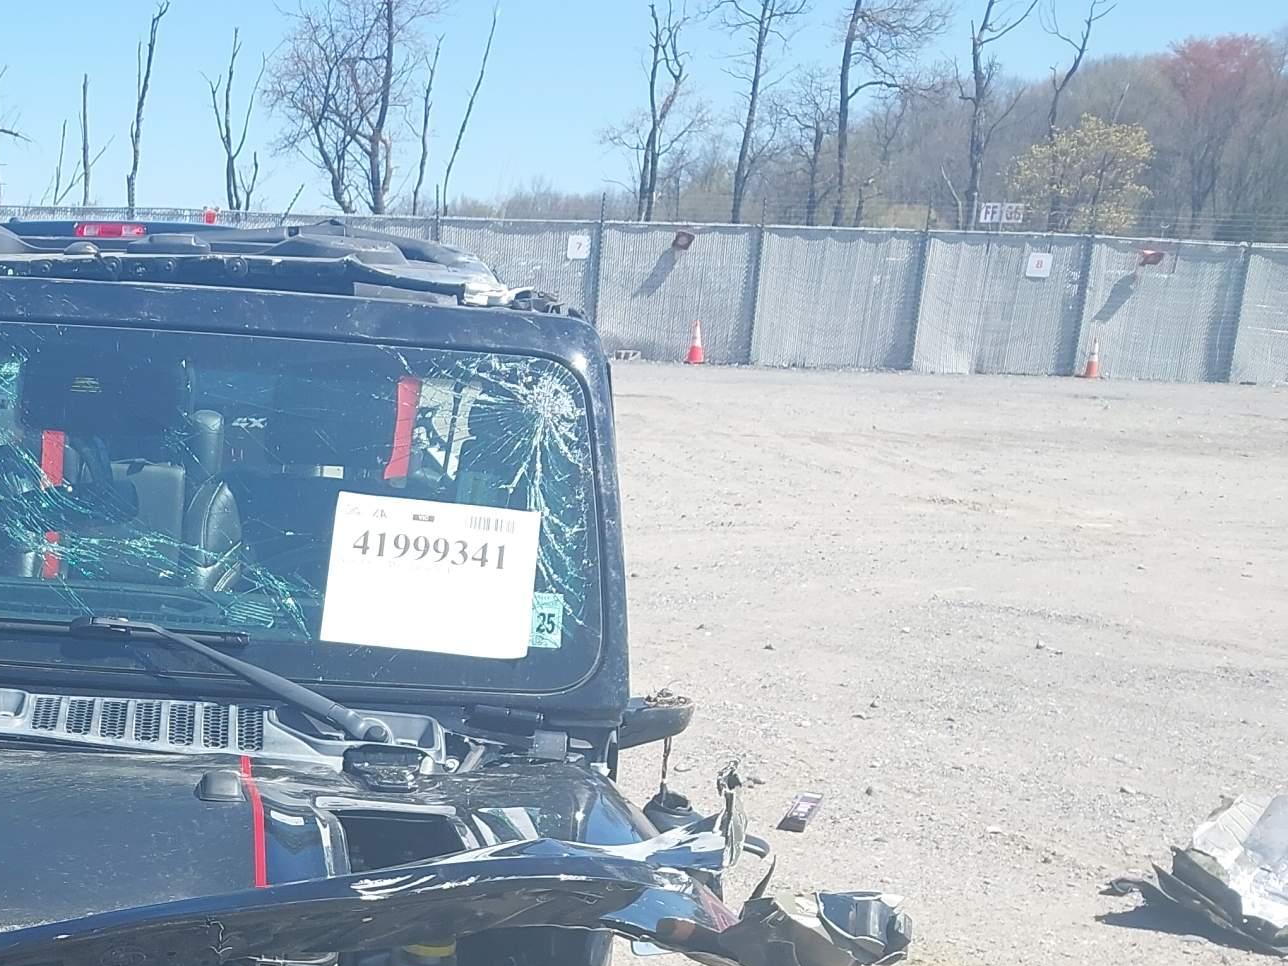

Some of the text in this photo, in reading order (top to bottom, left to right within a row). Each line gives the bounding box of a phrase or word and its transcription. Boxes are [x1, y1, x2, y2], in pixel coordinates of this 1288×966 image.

[983, 205, 999, 221] FF
[575, 241, 582, 251] 7
[352, 529, 507, 570] 41999341
[535, 612, 556, 635] 25
